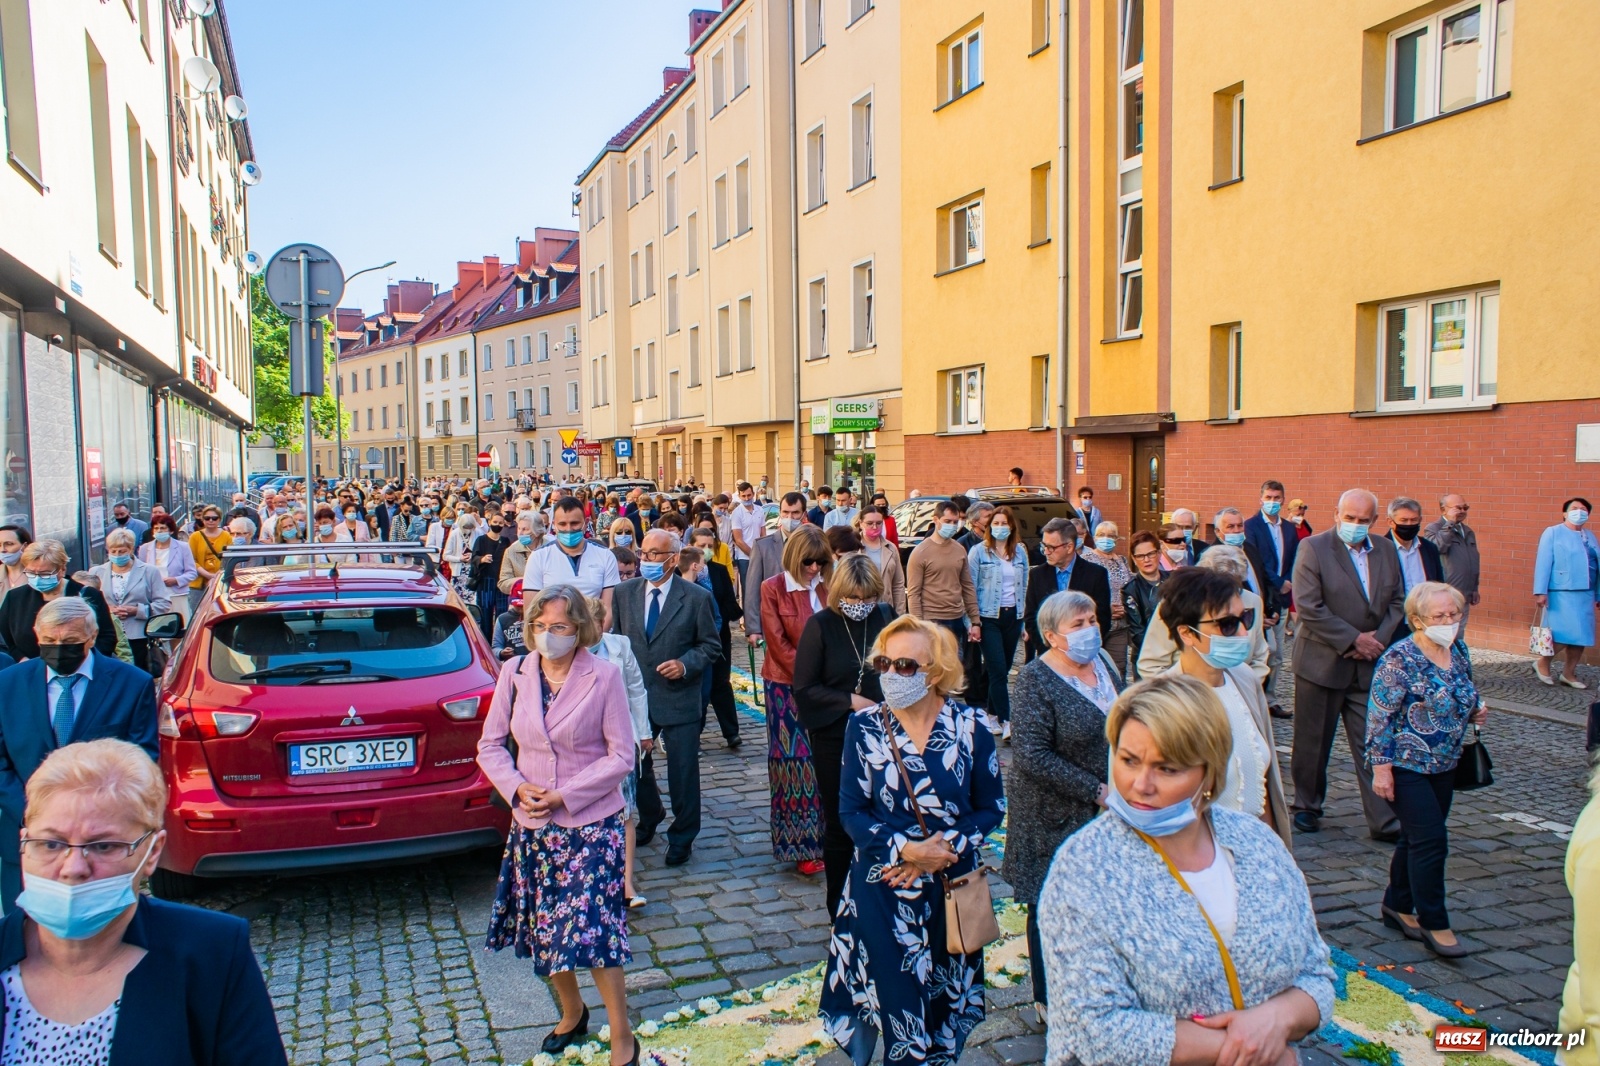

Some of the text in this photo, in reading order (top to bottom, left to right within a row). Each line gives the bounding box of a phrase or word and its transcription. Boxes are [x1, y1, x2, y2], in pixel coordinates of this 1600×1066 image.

[836, 403, 868, 413] GEERS
[857, 419, 877, 427] SŁUCH
[618, 442, 628, 455] P
[305, 740, 408, 767] SRC 3XE9
[434, 757, 474, 767] LANCER
